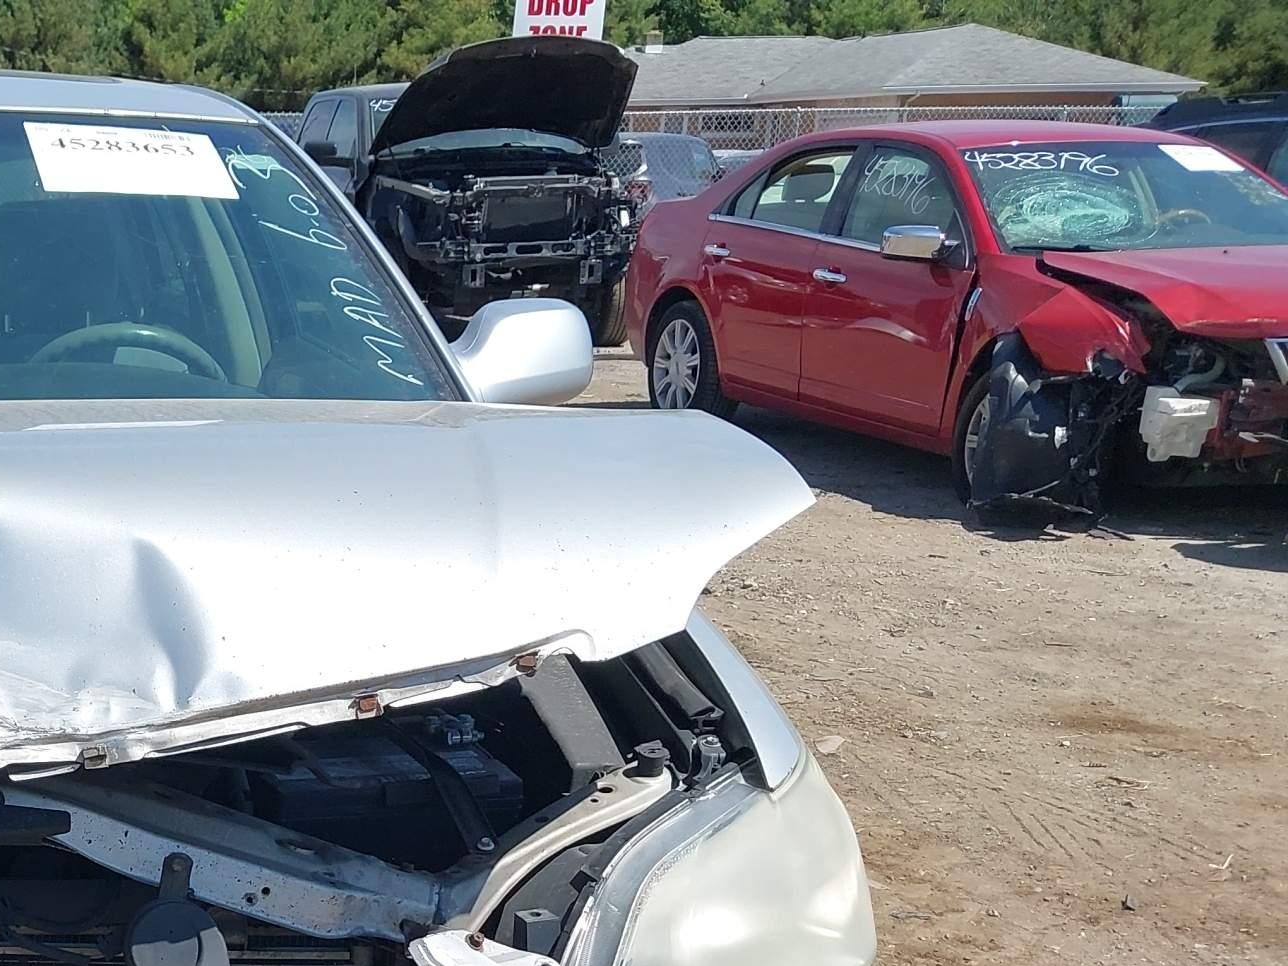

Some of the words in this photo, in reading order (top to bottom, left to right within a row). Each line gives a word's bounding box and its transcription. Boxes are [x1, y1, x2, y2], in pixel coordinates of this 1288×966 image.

[527, 0, 595, 16] DROP
[51, 137, 194, 156] 45283653
[964, 151, 1120, 177] 45283196
[330, 277, 424, 386] MAD
